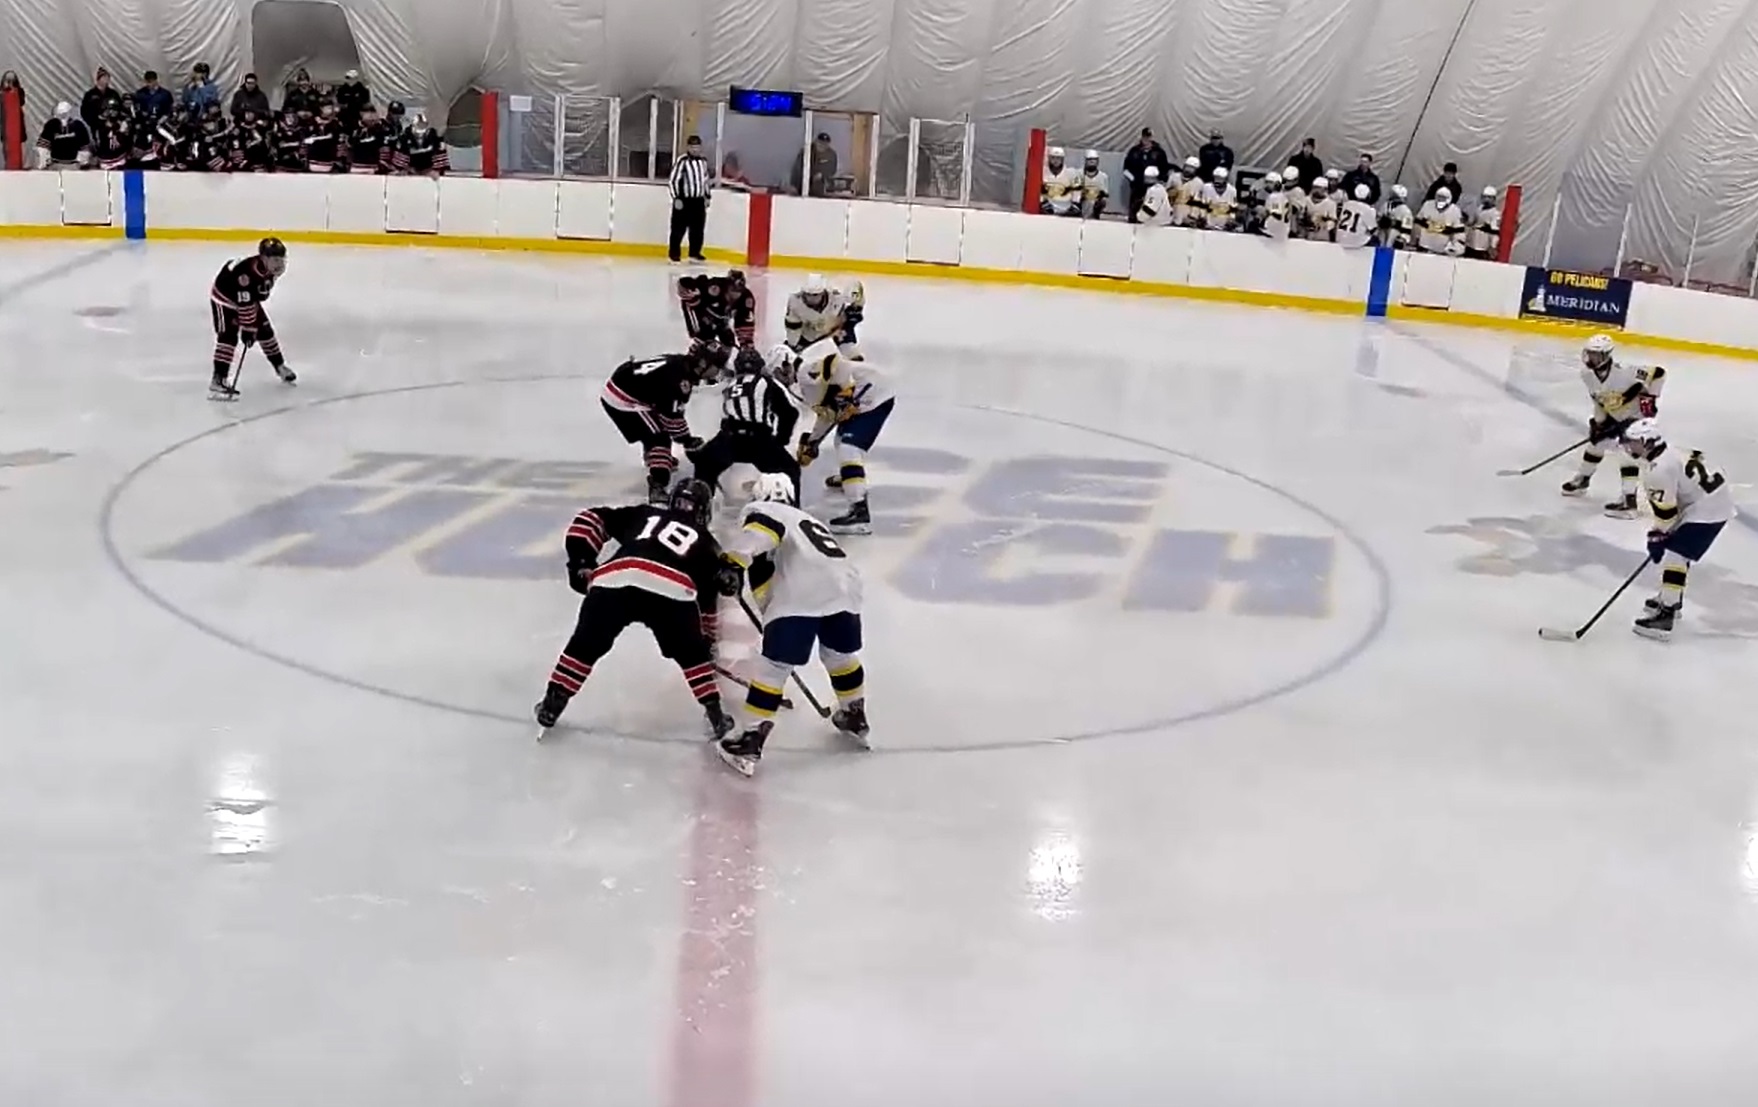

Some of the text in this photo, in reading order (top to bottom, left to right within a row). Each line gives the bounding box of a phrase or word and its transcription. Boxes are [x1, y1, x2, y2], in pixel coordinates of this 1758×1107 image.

[1339, 209, 1361, 233] 21
[1550, 271, 1611, 290] GO PELICANS!
[237, 291, 251, 303] 19
[1546, 294, 1621, 314] MERIDIAN
[638, 514, 699, 556] 18
[797, 518, 847, 559] 6
